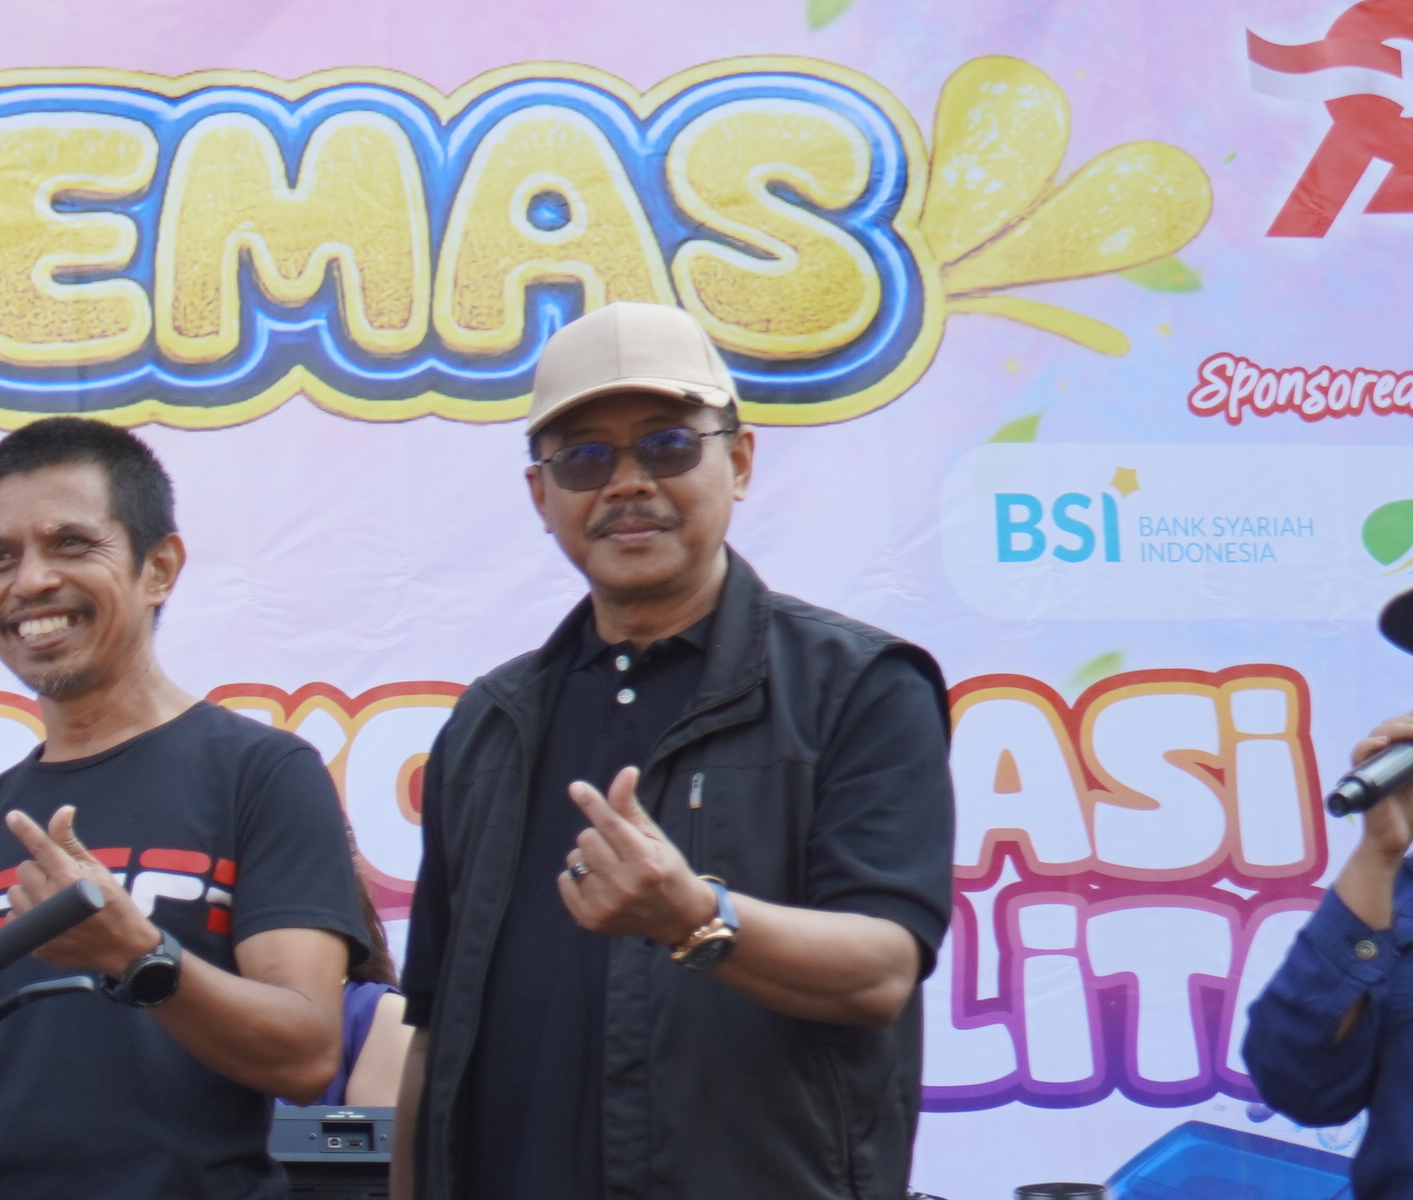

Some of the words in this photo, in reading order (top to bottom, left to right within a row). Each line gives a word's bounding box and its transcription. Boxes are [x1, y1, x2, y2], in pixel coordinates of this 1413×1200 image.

[993, 490, 1122, 564] BSI
[1138, 515, 1206, 539] BANK
[1212, 515, 1315, 538] SYARIAH
[1138, 541, 1277, 564] INDONESIA
